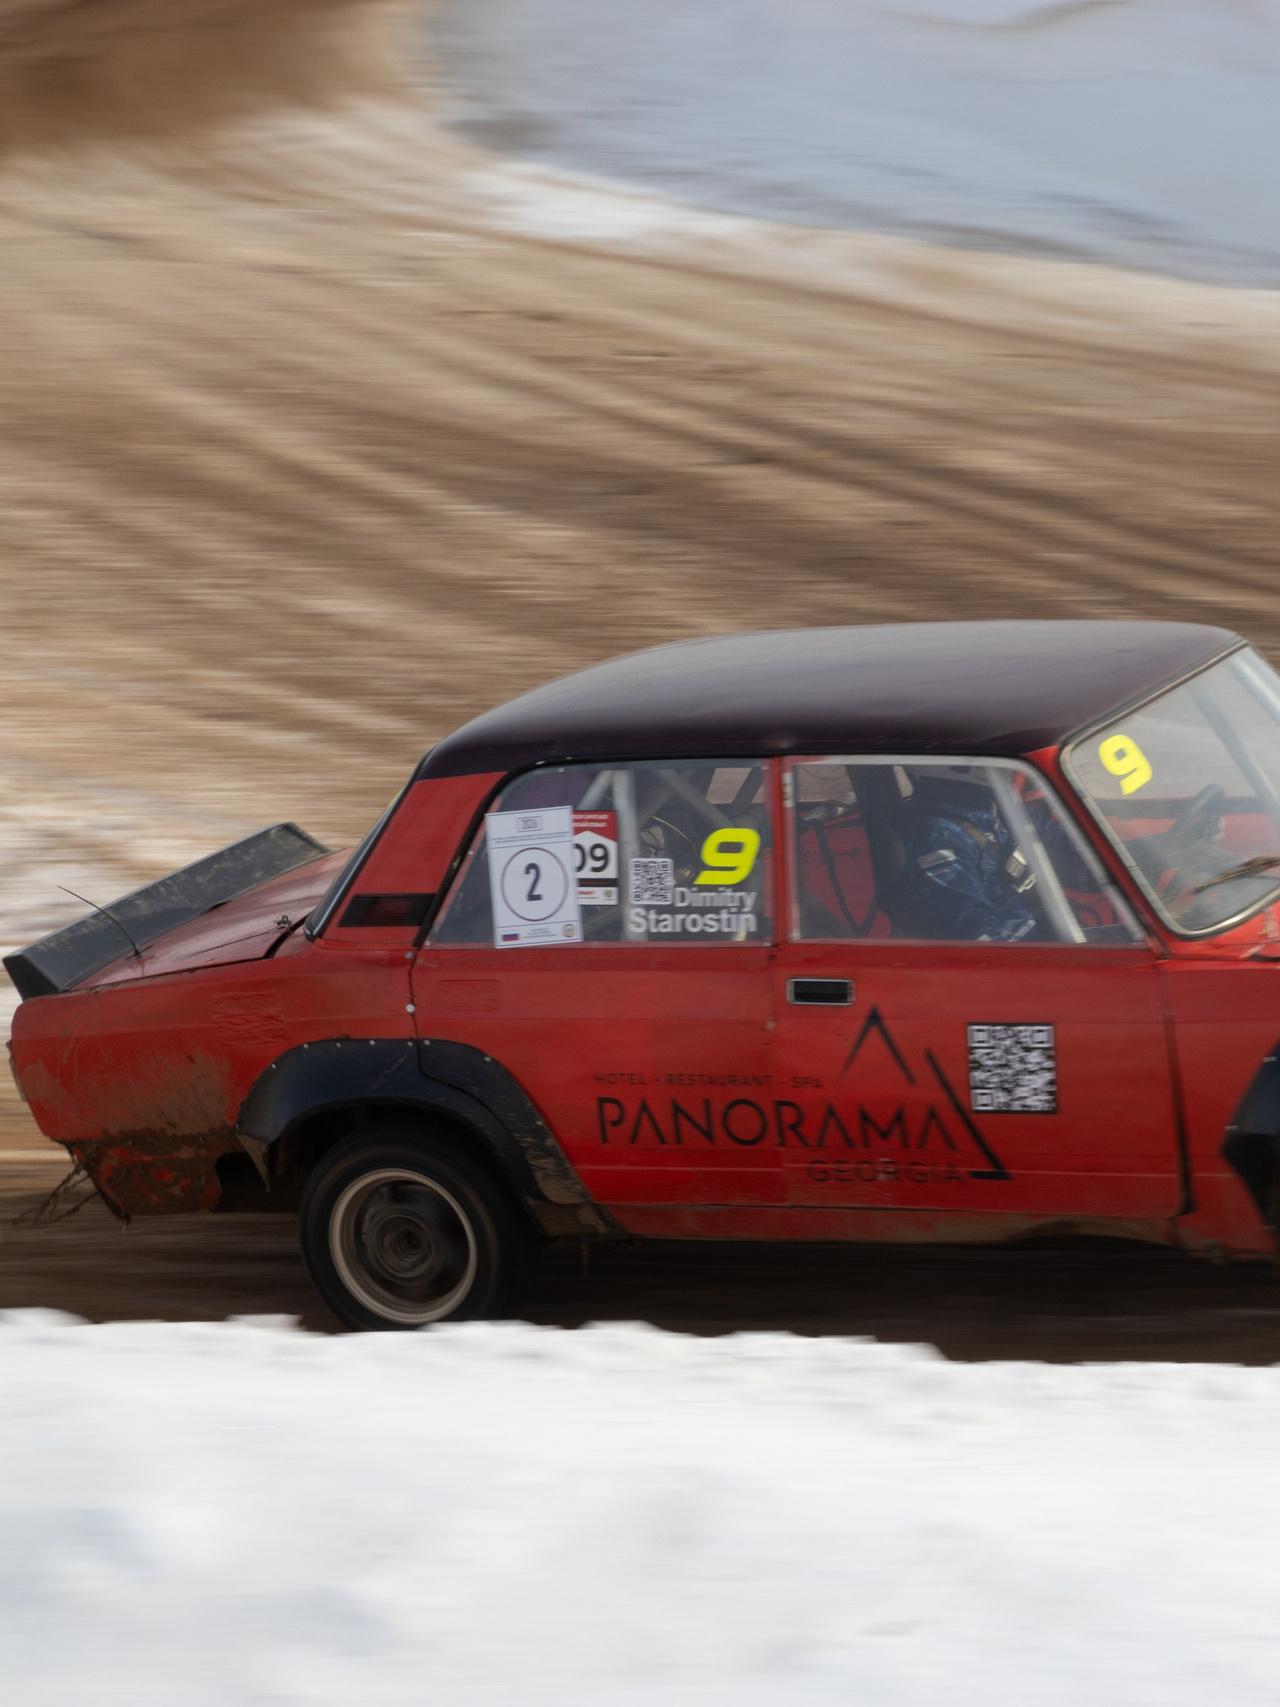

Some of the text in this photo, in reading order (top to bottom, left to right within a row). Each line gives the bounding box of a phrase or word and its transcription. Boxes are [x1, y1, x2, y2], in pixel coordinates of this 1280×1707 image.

[1098, 734, 1153, 795] 9
[693, 828, 761, 885] 9
[524, 863, 543, 902] 2
[674, 887, 757, 912] Dimitry
[628, 907, 757, 932] Starostin
[594, 1073, 648, 1086] HOTEL
[596, 1097, 957, 1151] PANORAMA
[808, 1160, 965, 1184] GEORGIA
